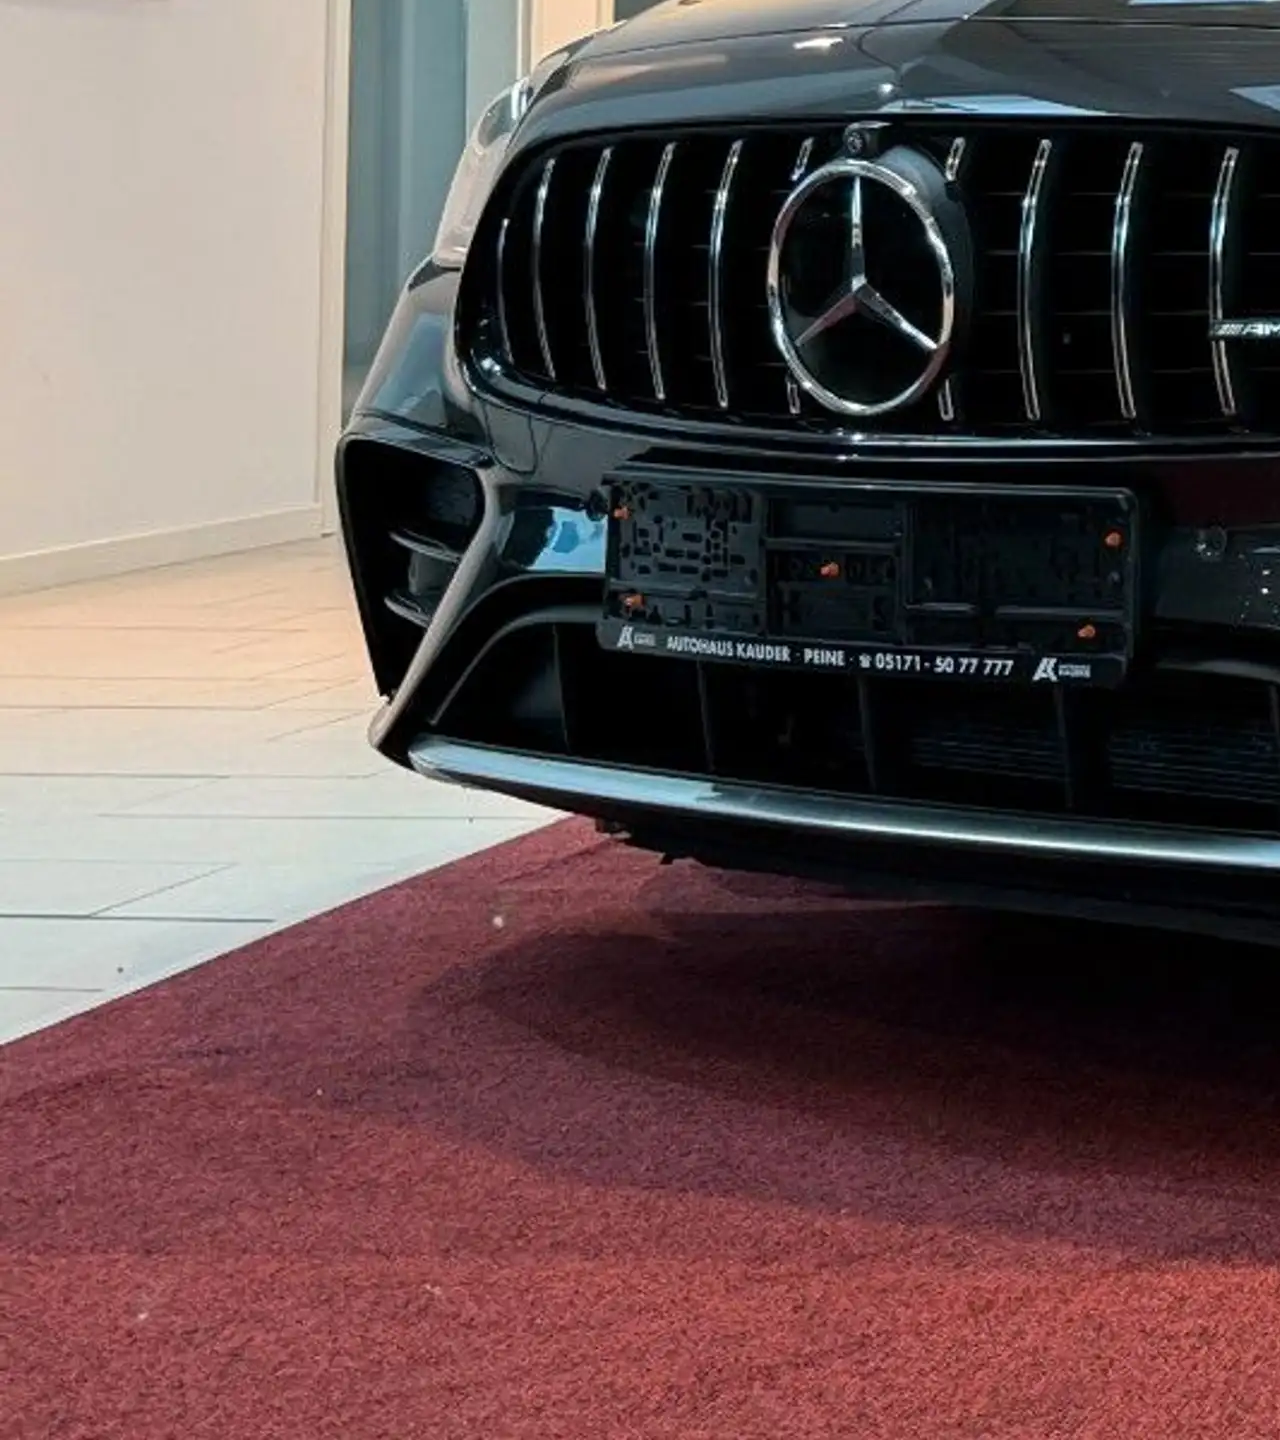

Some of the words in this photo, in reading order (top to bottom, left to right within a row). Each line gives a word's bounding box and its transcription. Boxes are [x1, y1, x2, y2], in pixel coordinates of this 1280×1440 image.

[667, 635, 733, 657] AUTOHAUS
[736, 642, 791, 662] KAUDER
[803, 648, 846, 666] PEINE
[875, 652, 921, 672] 05171
[933, 656, 955, 674] 50
[958, 657, 979, 675] 77
[983, 659, 1014, 677] 777
